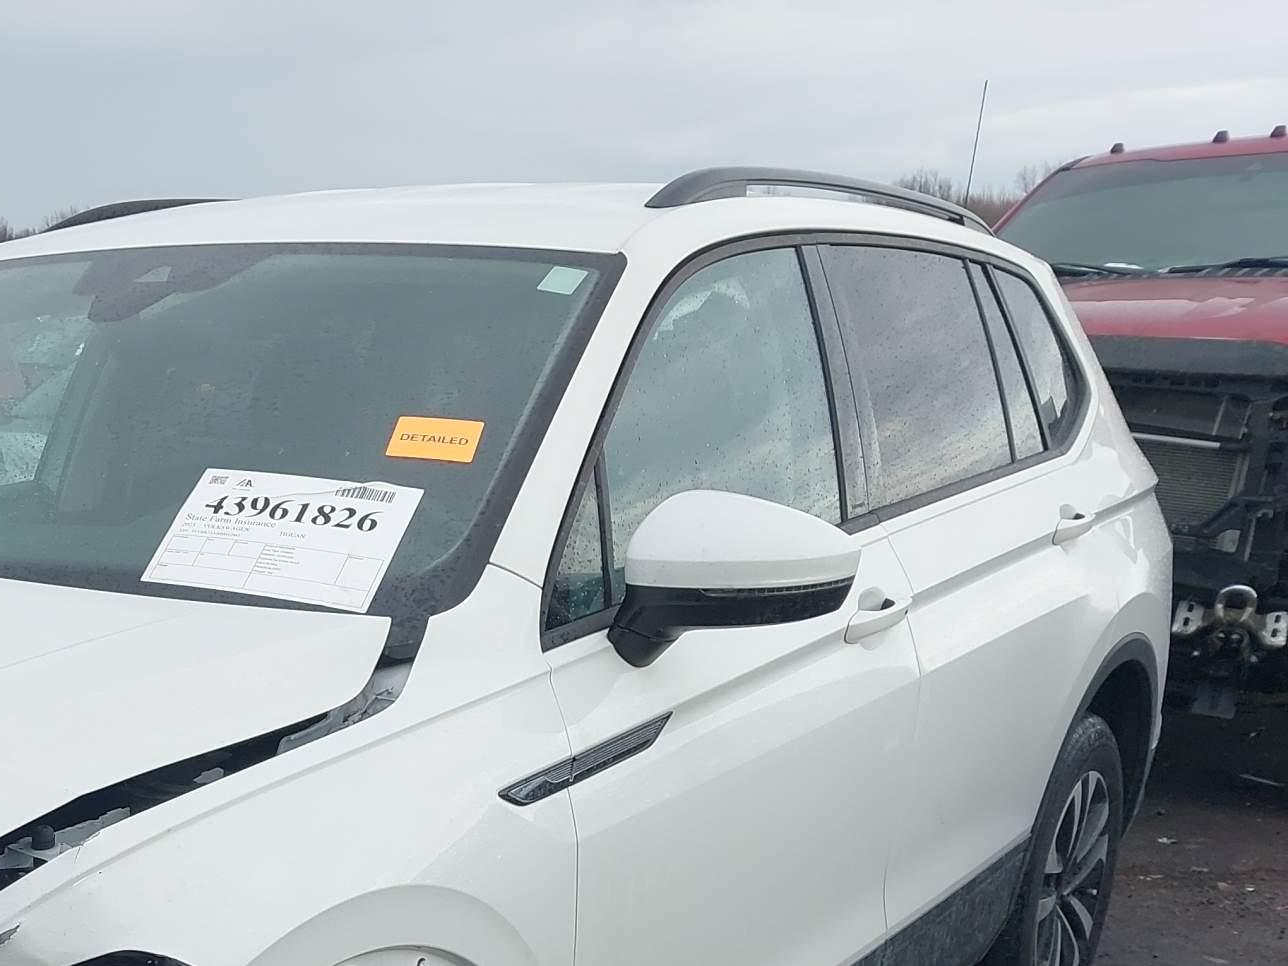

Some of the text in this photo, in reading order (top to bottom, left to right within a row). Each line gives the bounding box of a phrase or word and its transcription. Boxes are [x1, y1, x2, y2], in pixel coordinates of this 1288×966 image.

[399, 433, 470, 446] DETAILED
[185, 512, 277, 529] State Farm Insurance
[204, 495, 385, 533] 43961826
